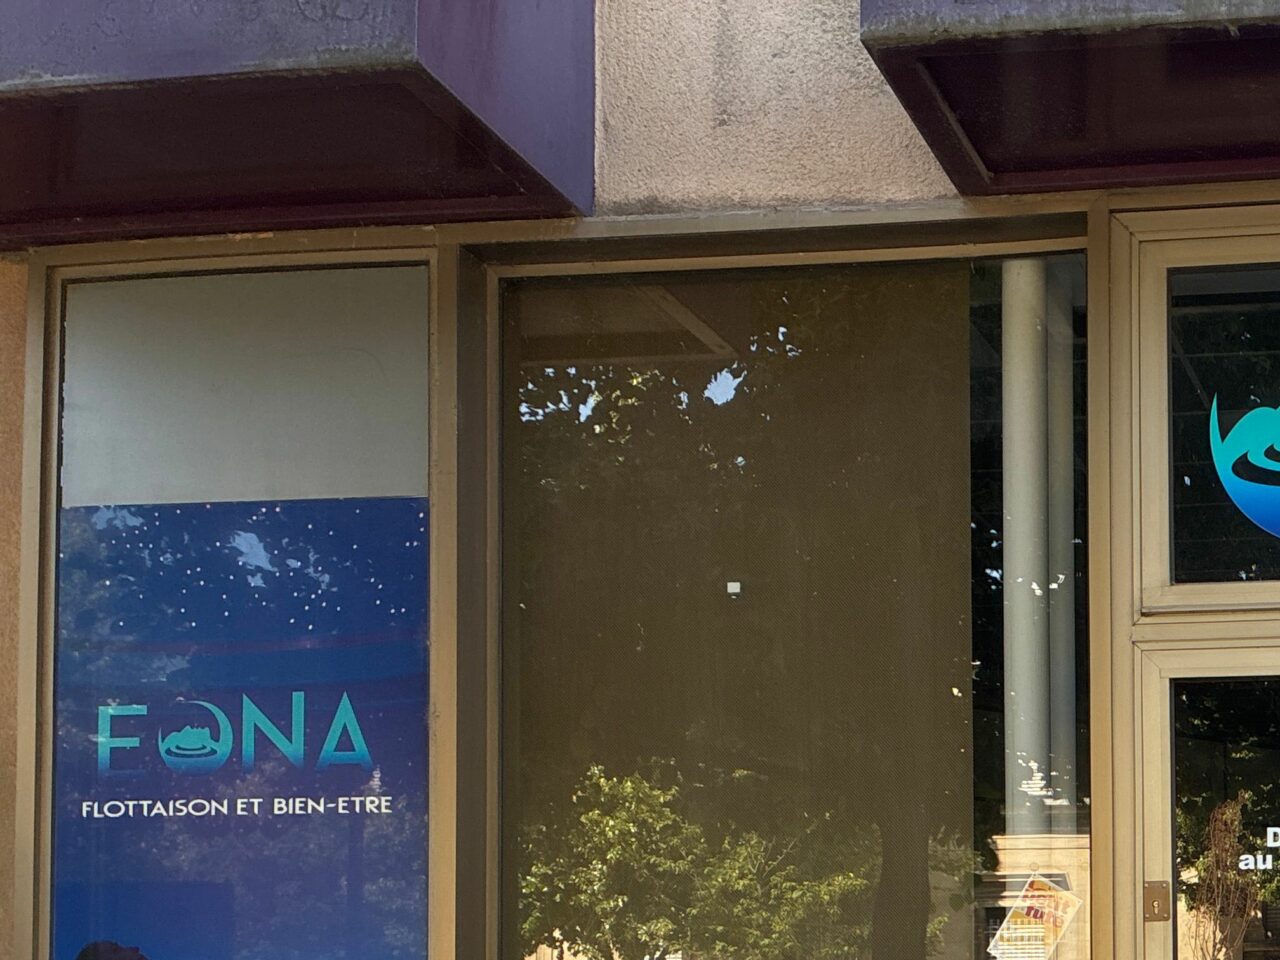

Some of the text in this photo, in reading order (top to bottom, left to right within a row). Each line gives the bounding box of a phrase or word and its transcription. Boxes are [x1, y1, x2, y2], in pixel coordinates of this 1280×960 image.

[82, 796, 393, 818] FLOTTAISON ET BIEN-ETRE
[1238, 852, 1273, 870] au
